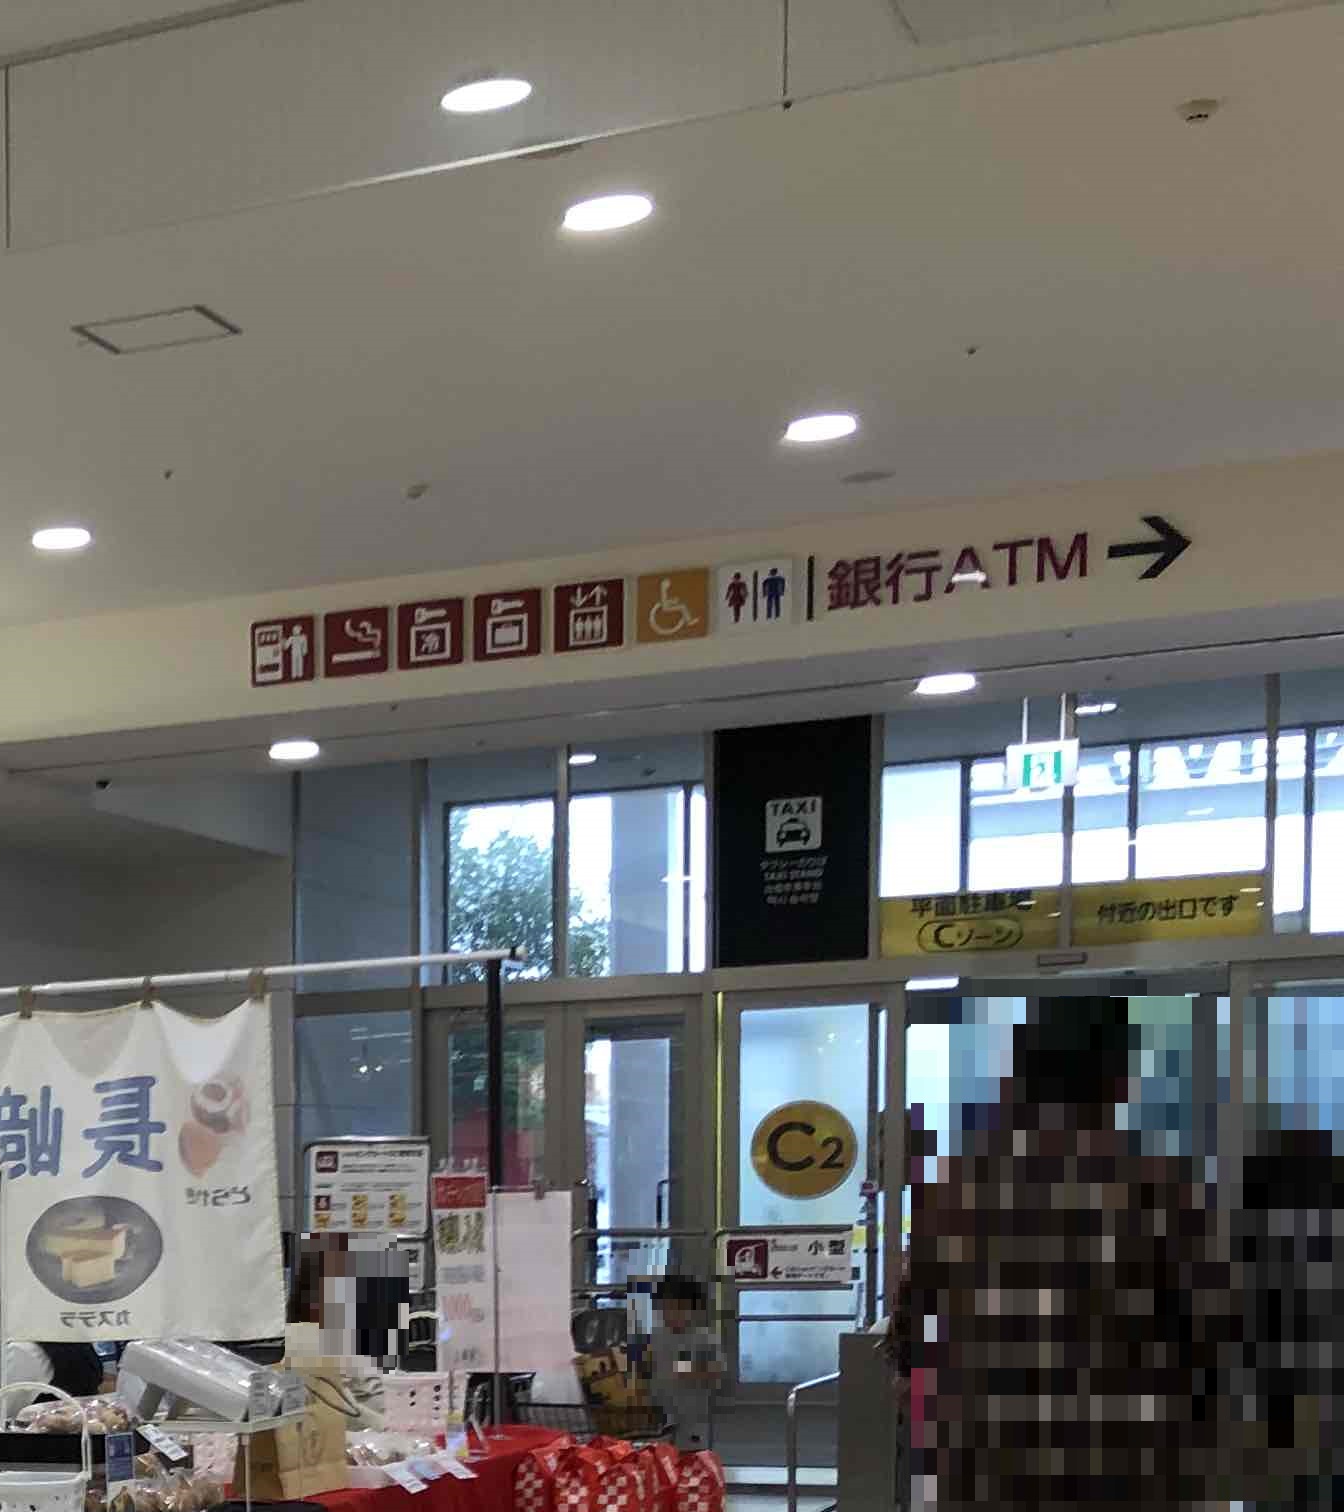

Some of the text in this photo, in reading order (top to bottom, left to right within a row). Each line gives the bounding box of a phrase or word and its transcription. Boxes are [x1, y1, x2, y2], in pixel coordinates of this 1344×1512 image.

[824, 531, 1089, 612] 銀行ATM
[770, 799, 816, 816] TAXI
[765, 1120, 845, 1171] C2
